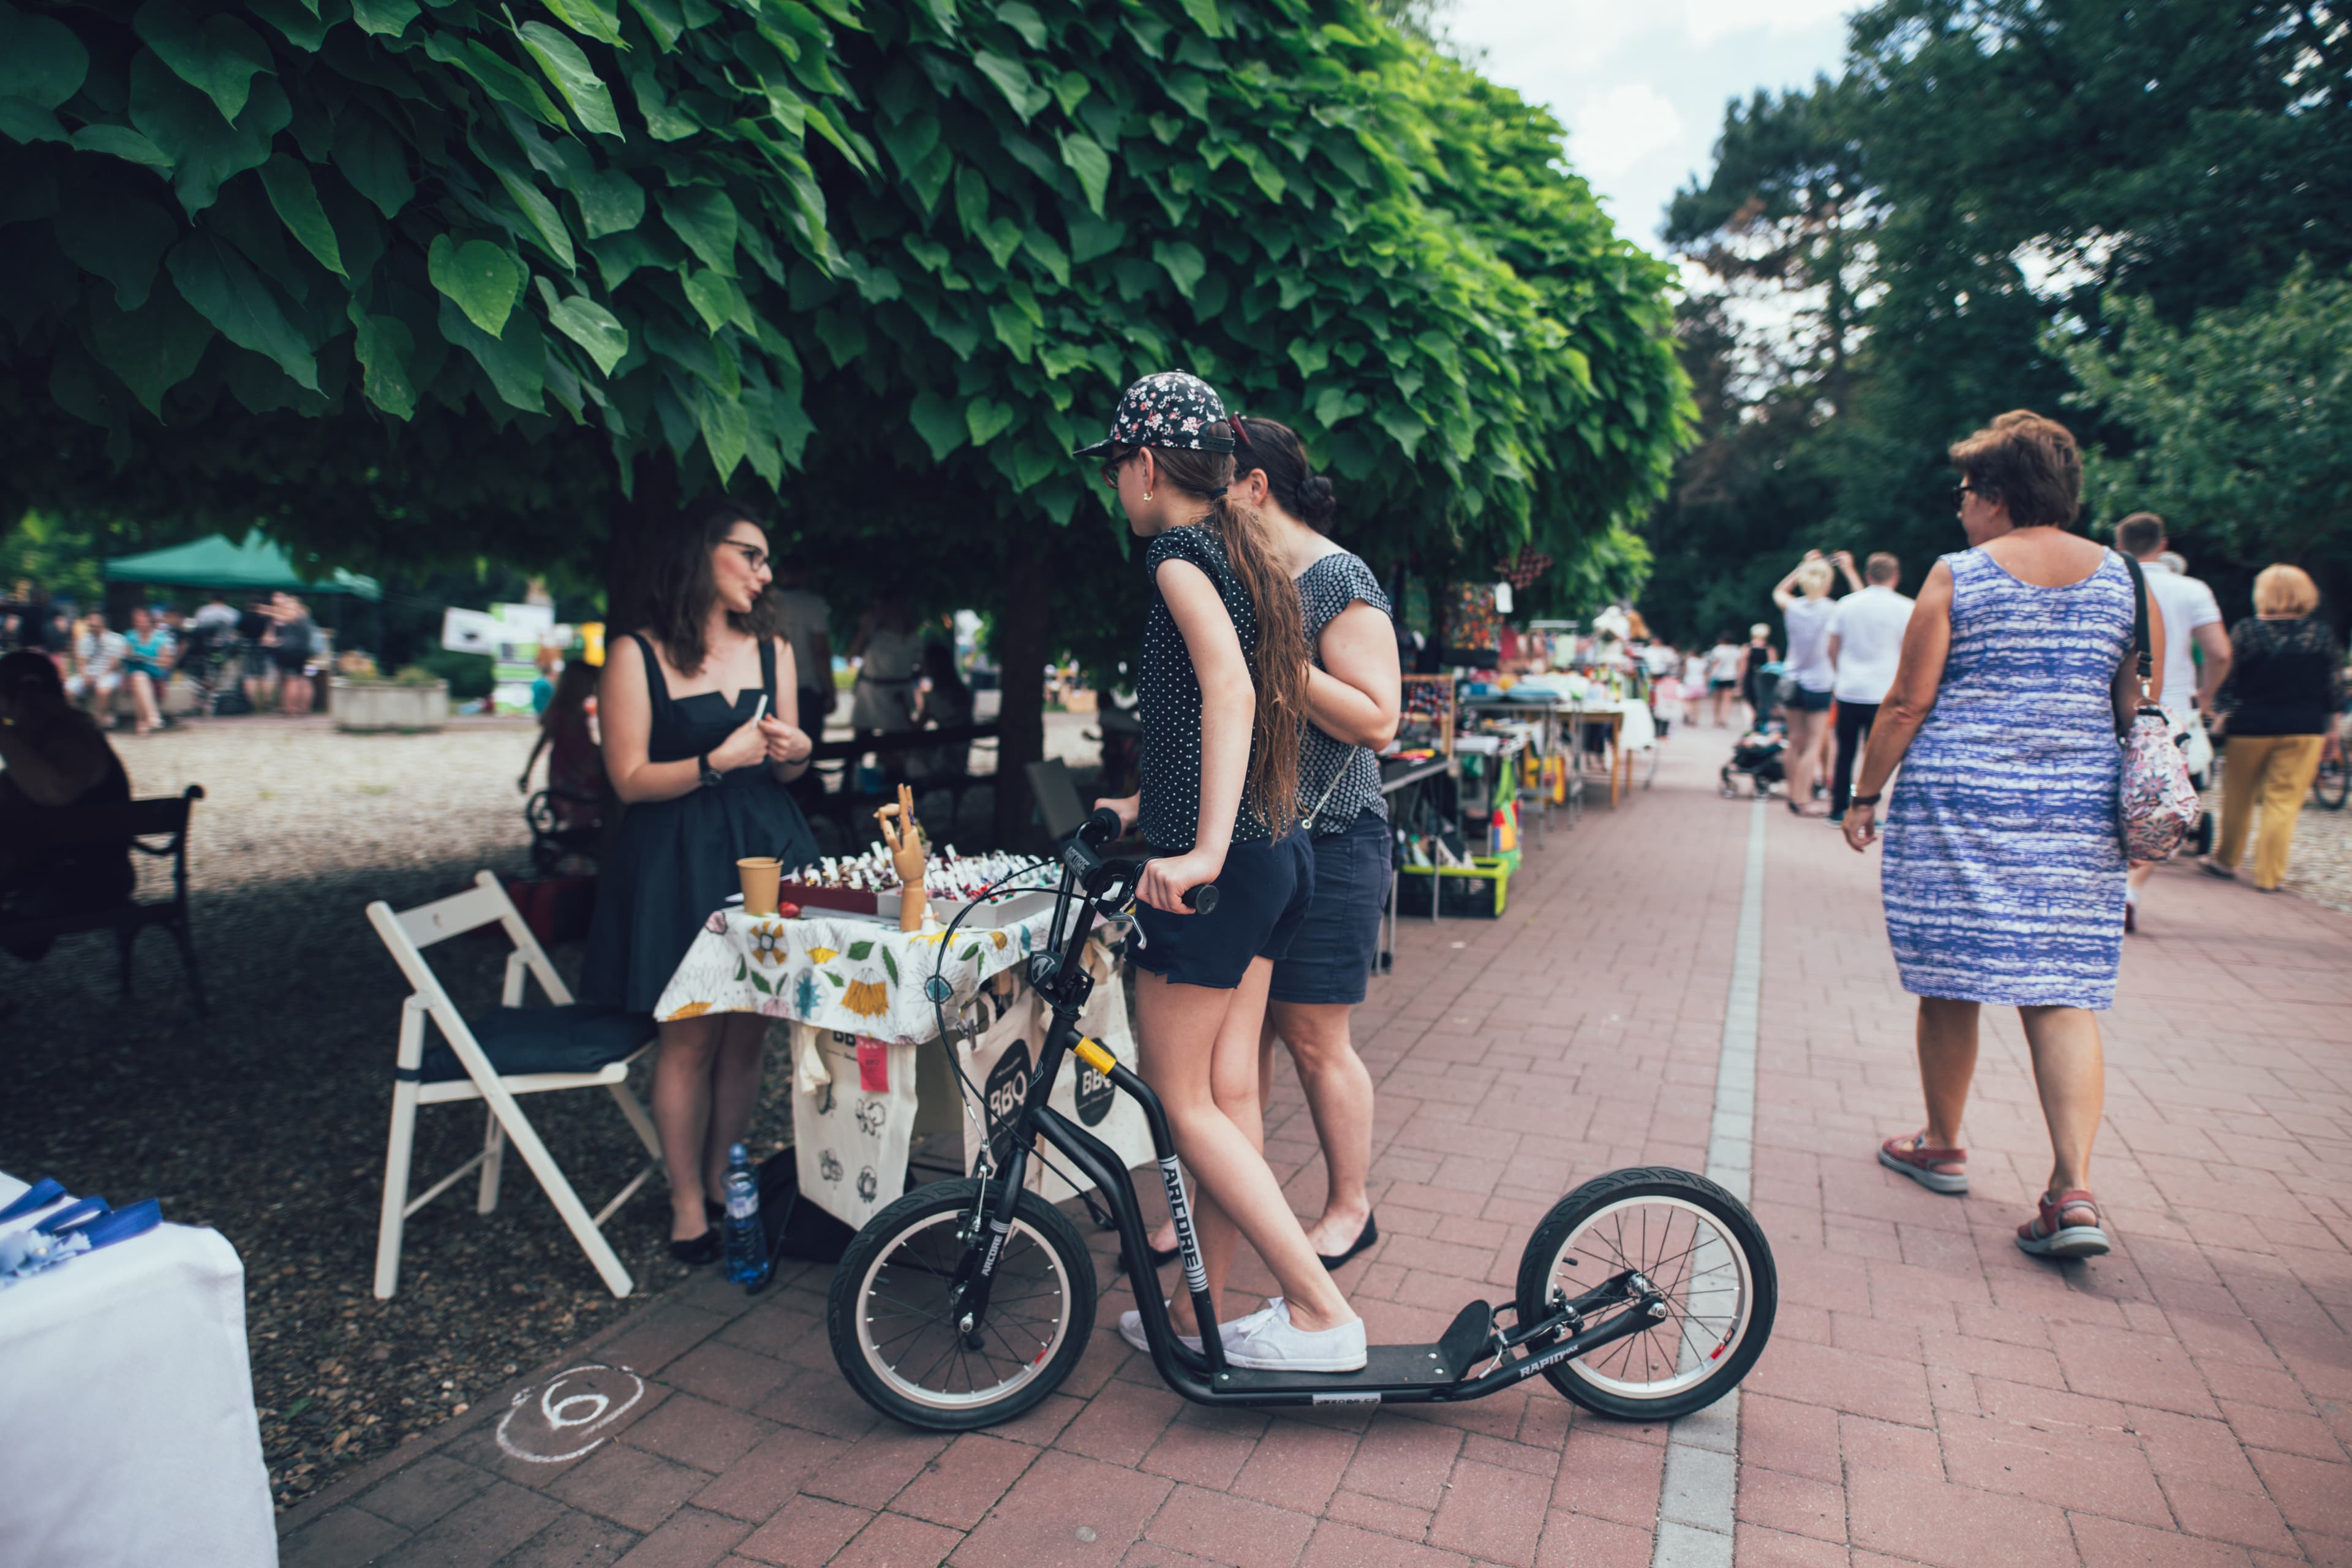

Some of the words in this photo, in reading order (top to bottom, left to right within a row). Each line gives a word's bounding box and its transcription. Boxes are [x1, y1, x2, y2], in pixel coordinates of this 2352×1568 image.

[990, 1071, 1027, 1126] BBQ
[1164, 1167, 1199, 1268] ARCORE
[981, 1235, 1003, 1276] ARCORE
